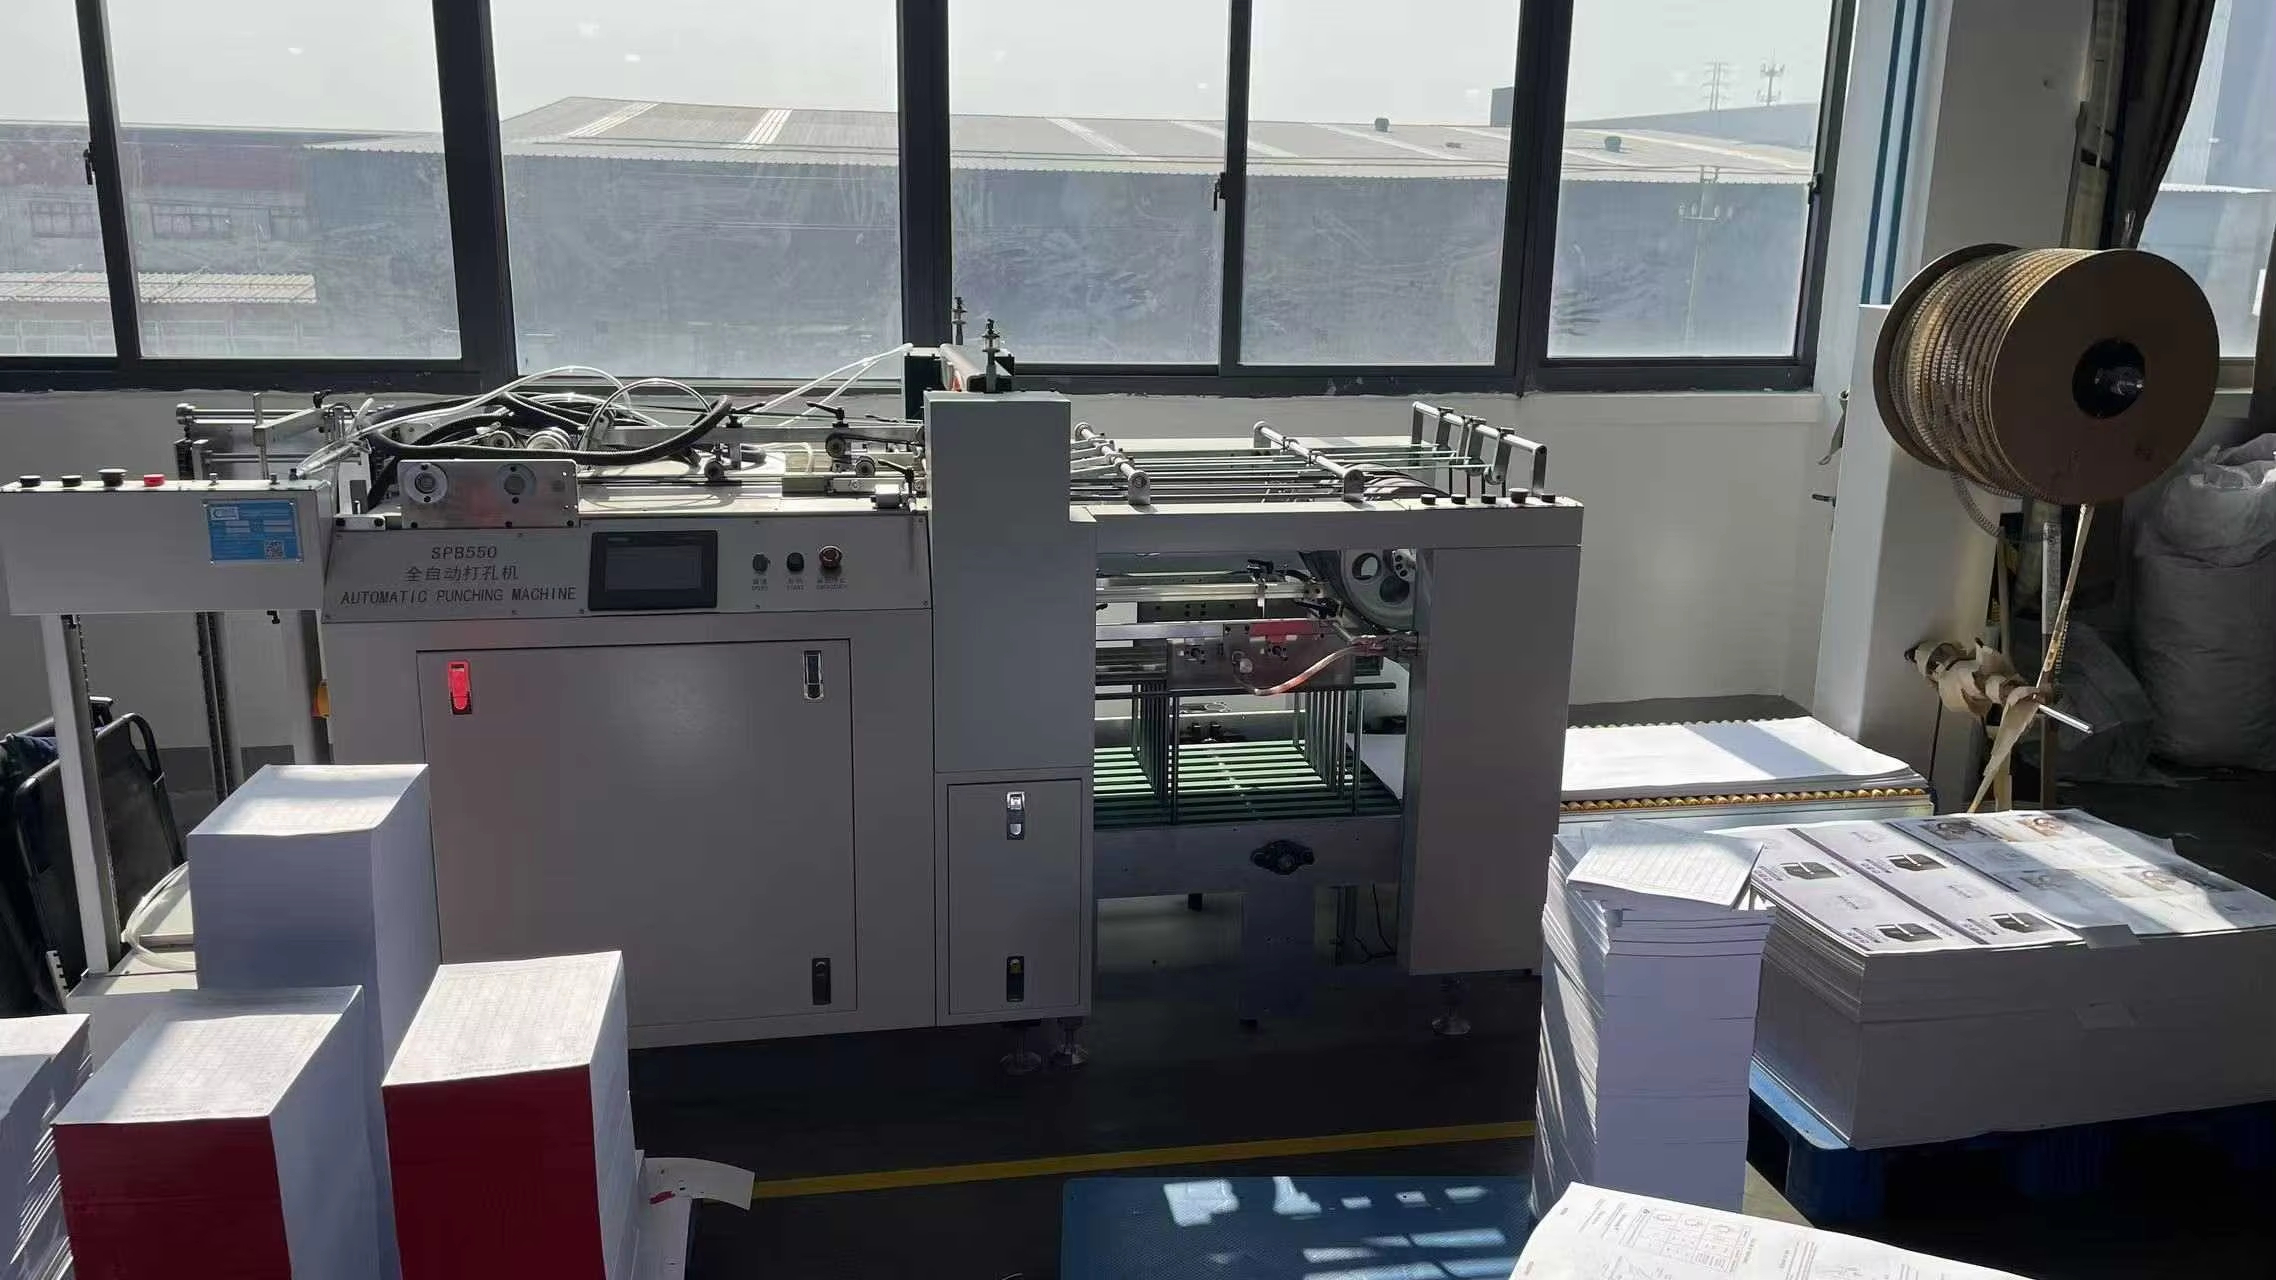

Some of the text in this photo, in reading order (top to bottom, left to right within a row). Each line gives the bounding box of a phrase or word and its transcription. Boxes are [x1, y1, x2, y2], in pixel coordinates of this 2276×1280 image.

[431, 545, 498, 560] SPB550
[405, 564, 520, 582] 全自动打孔机
[340, 586, 577, 605] AUTOMATIC PUNCHING MACHINE
